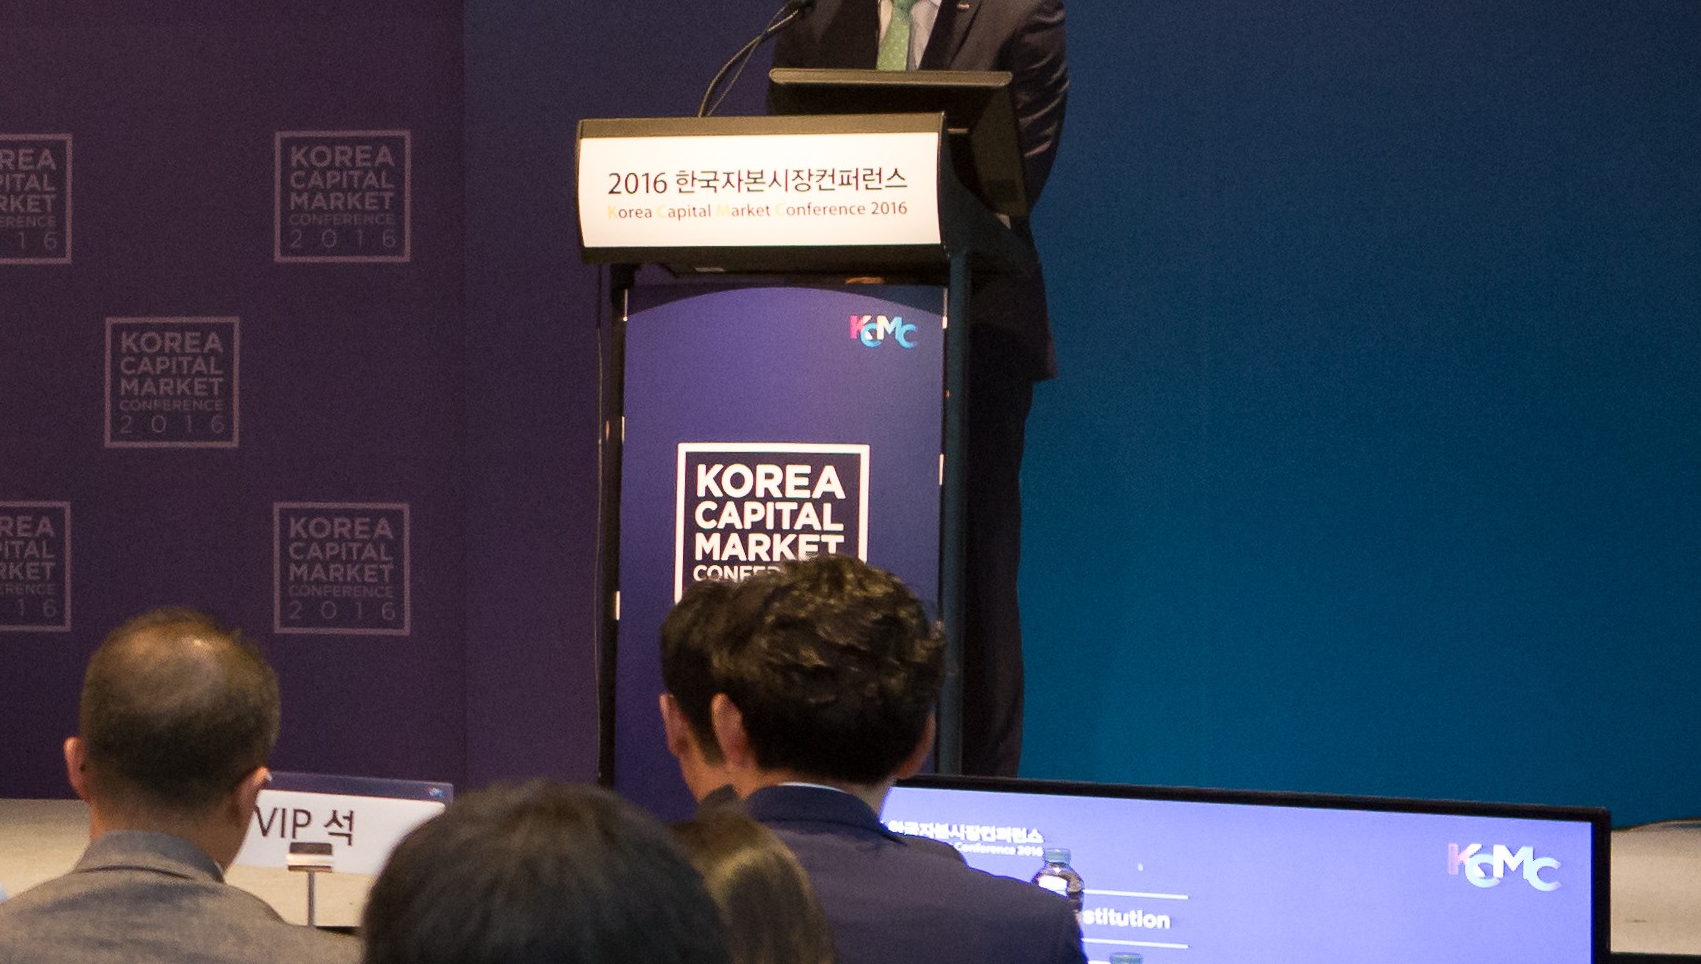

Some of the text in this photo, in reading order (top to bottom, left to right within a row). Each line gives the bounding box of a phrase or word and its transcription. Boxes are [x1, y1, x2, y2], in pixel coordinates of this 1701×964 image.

[290, 144, 395, 167] KOREA
[290, 169, 395, 189] CAPITAL
[608, 167, 908, 195] 2016 한국자본시장컨퍼런스
[290, 191, 396, 211] MARKET
[607, 201, 908, 221] Korea Capital Market Conference 2016
[121, 331, 223, 353] KOREA
[120, 356, 223, 375] CAPITAL
[120, 377, 224, 396] MARKET
[696, 463, 847, 499] KOREA
[694, 501, 845, 531] CAPITAL
[289, 516, 394, 539] KOREA
[289, 541, 394, 561] CAPITAL
[694, 532, 845, 562] MARKET
[289, 563, 395, 582] MARKET
[255, 806, 355, 846] VIP 석
[1082, 907, 1171, 930] stitution
